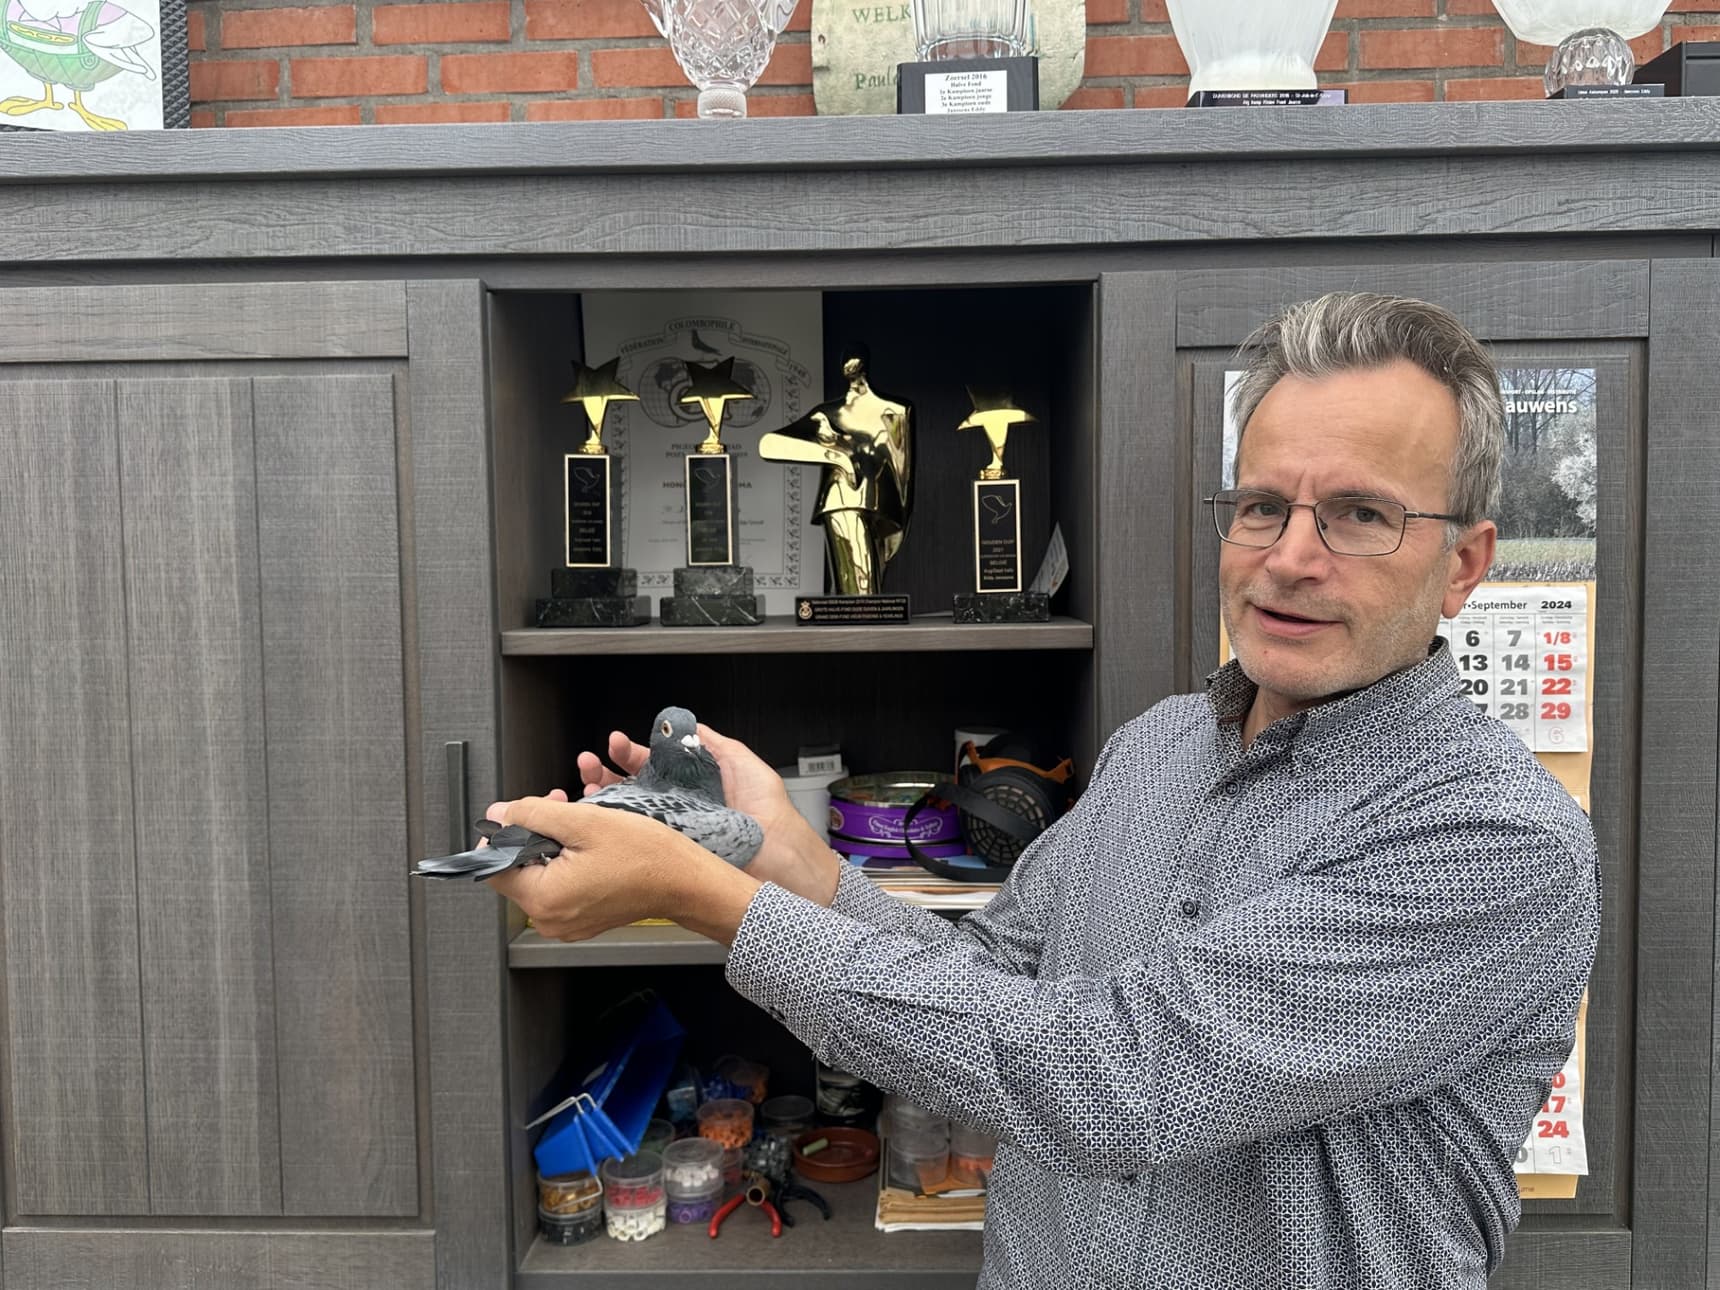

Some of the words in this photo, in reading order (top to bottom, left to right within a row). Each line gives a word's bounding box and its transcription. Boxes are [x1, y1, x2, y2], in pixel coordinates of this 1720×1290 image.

[1505, 400, 1578, 414] auwens
[1541, 600, 1572, 609] 2024
[1465, 630, 1480, 647] 6
[1507, 630, 1522, 647] 7
[1543, 631, 1572, 646] 1/8
[1459, 654, 1488, 671] 13
[1501, 654, 1530, 671] 14
[1543, 654, 1573, 671] 15
[1460, 679, 1489, 695] 20
[1500, 678, 1528, 695] 21
[1541, 678, 1571, 695] 22
[1500, 702, 1529, 720] 28
[1541, 702, 1571, 720] 29
[1551, 1072, 1566, 1089] 0
[1537, 1120, 1570, 1138] 24
[1514, 1147, 1528, 1163] 0
